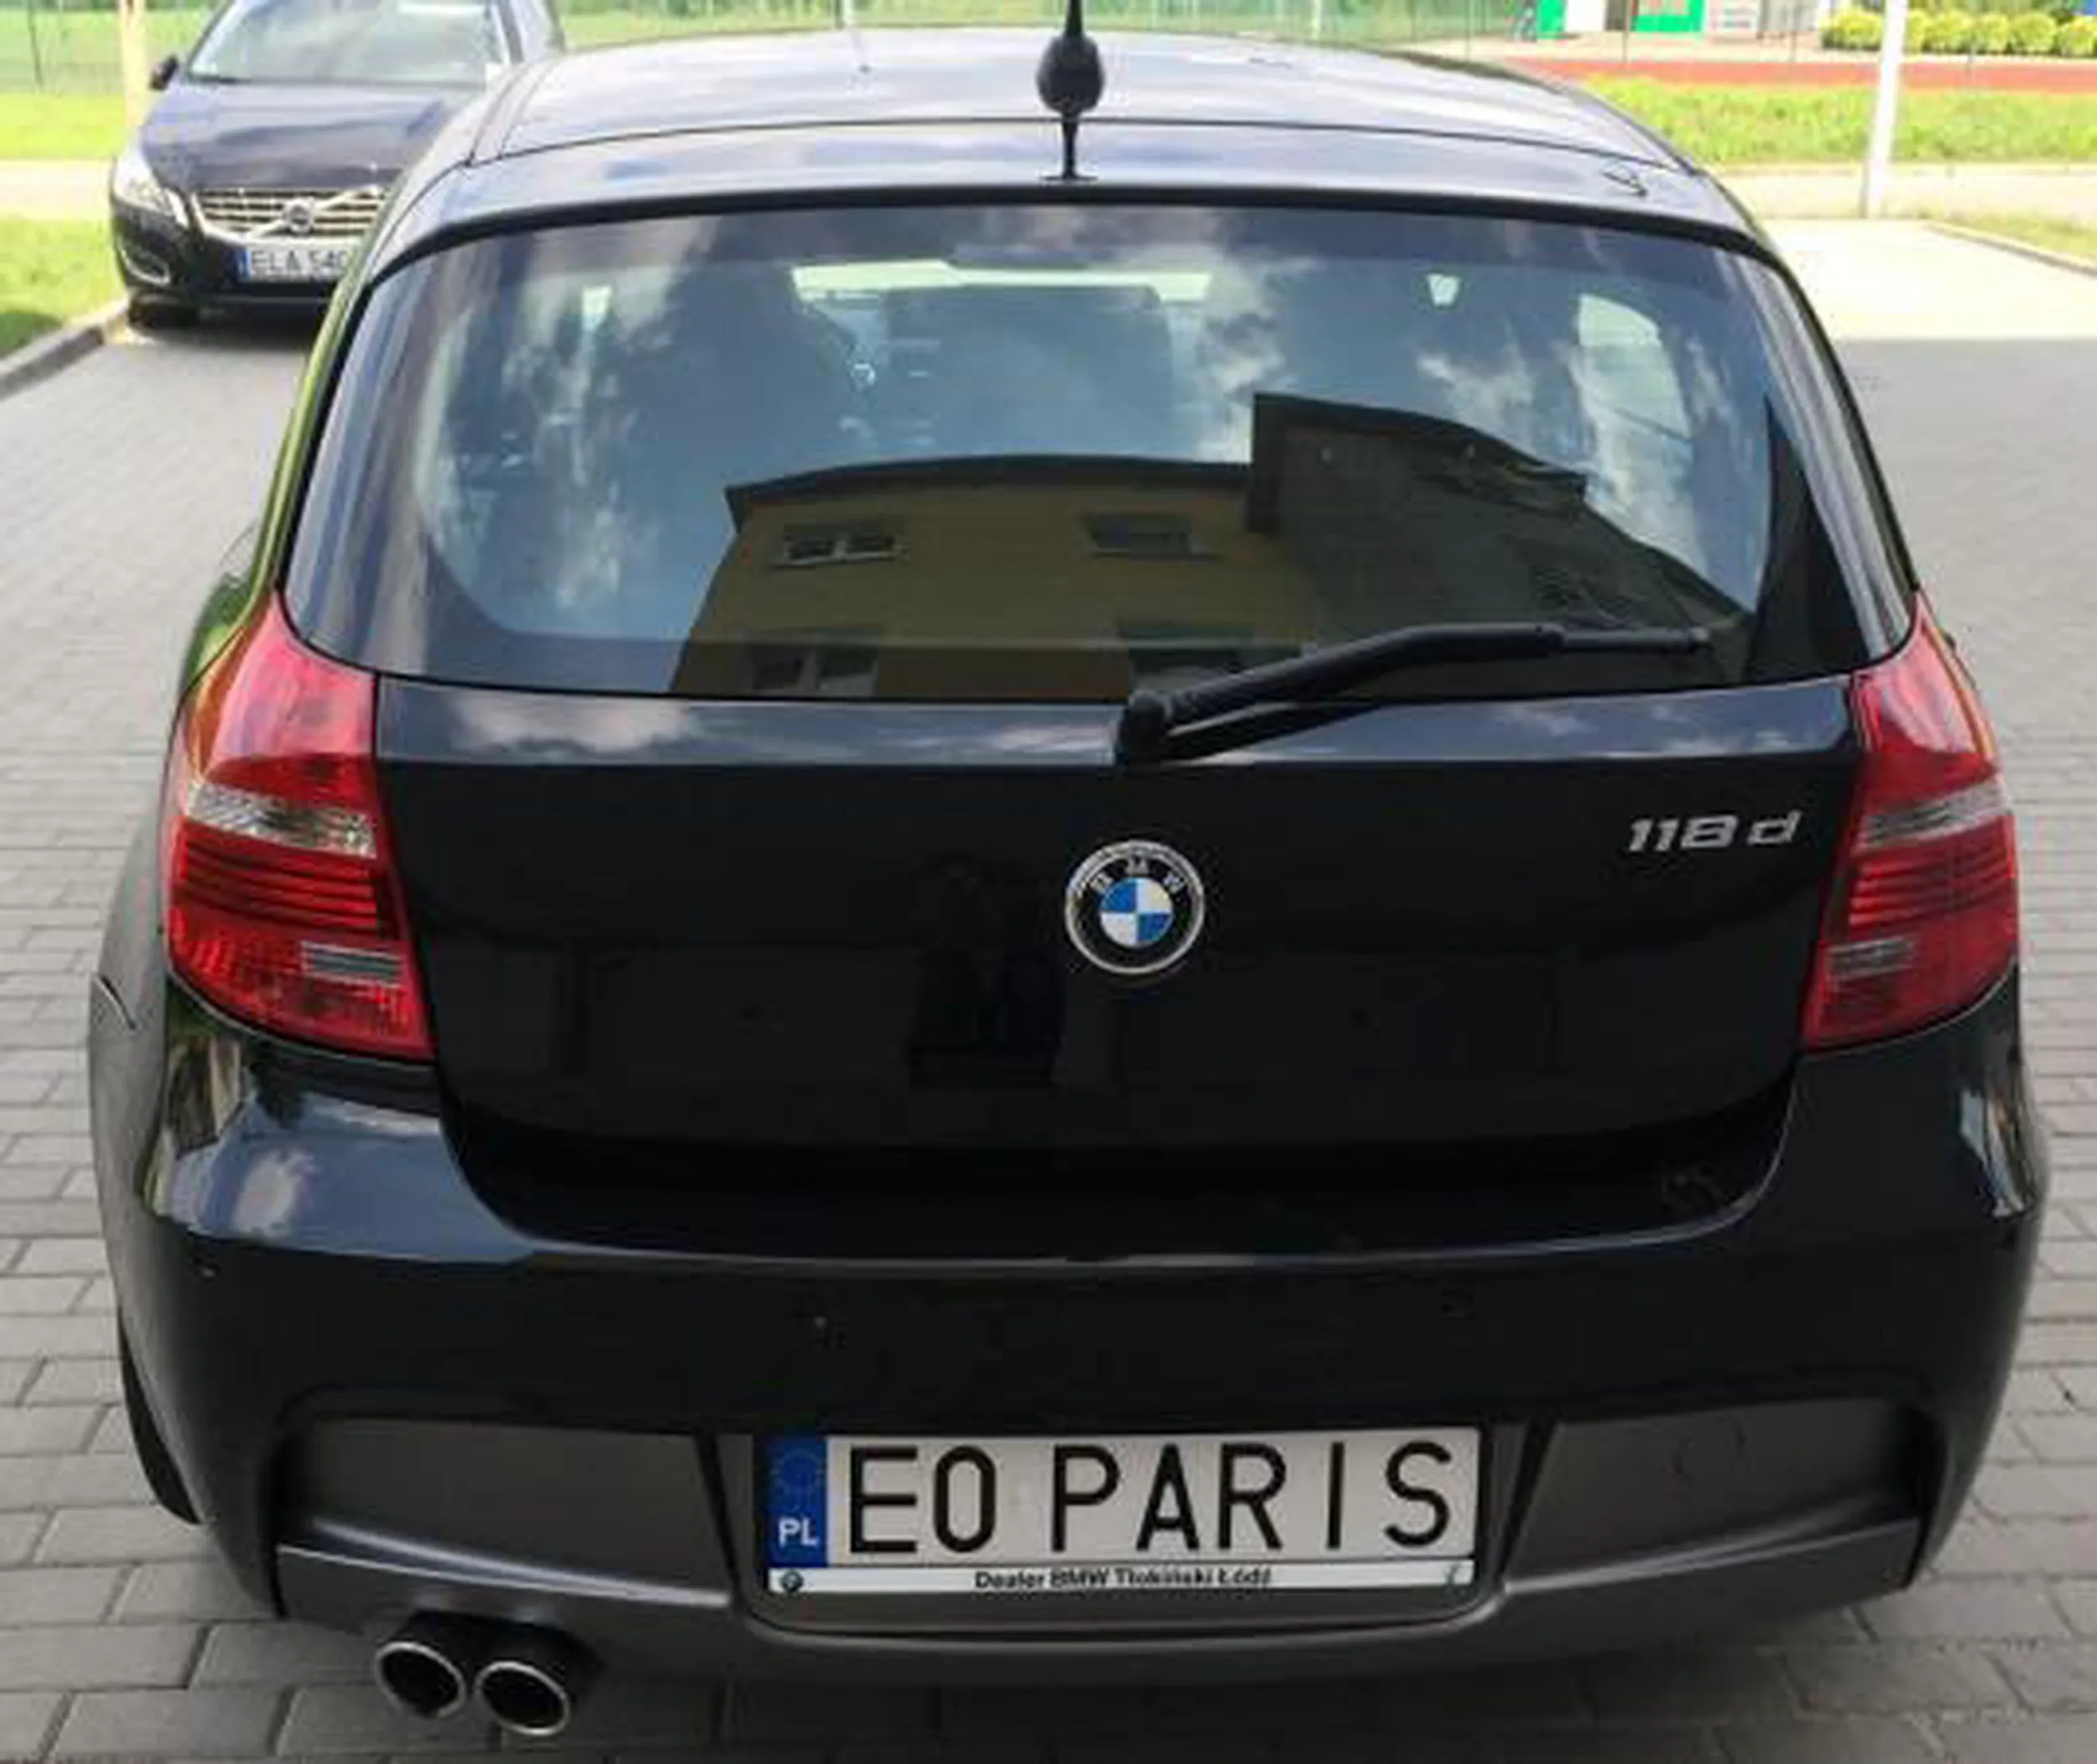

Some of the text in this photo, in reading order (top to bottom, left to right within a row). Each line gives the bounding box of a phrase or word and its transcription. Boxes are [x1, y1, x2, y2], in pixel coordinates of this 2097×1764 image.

[1051, 1439, 1453, 1553] PARIS
[778, 1516, 821, 1548] PL
[975, 1569, 1045, 1589] Dealer
[1049, 1566, 1110, 1588] BMW
